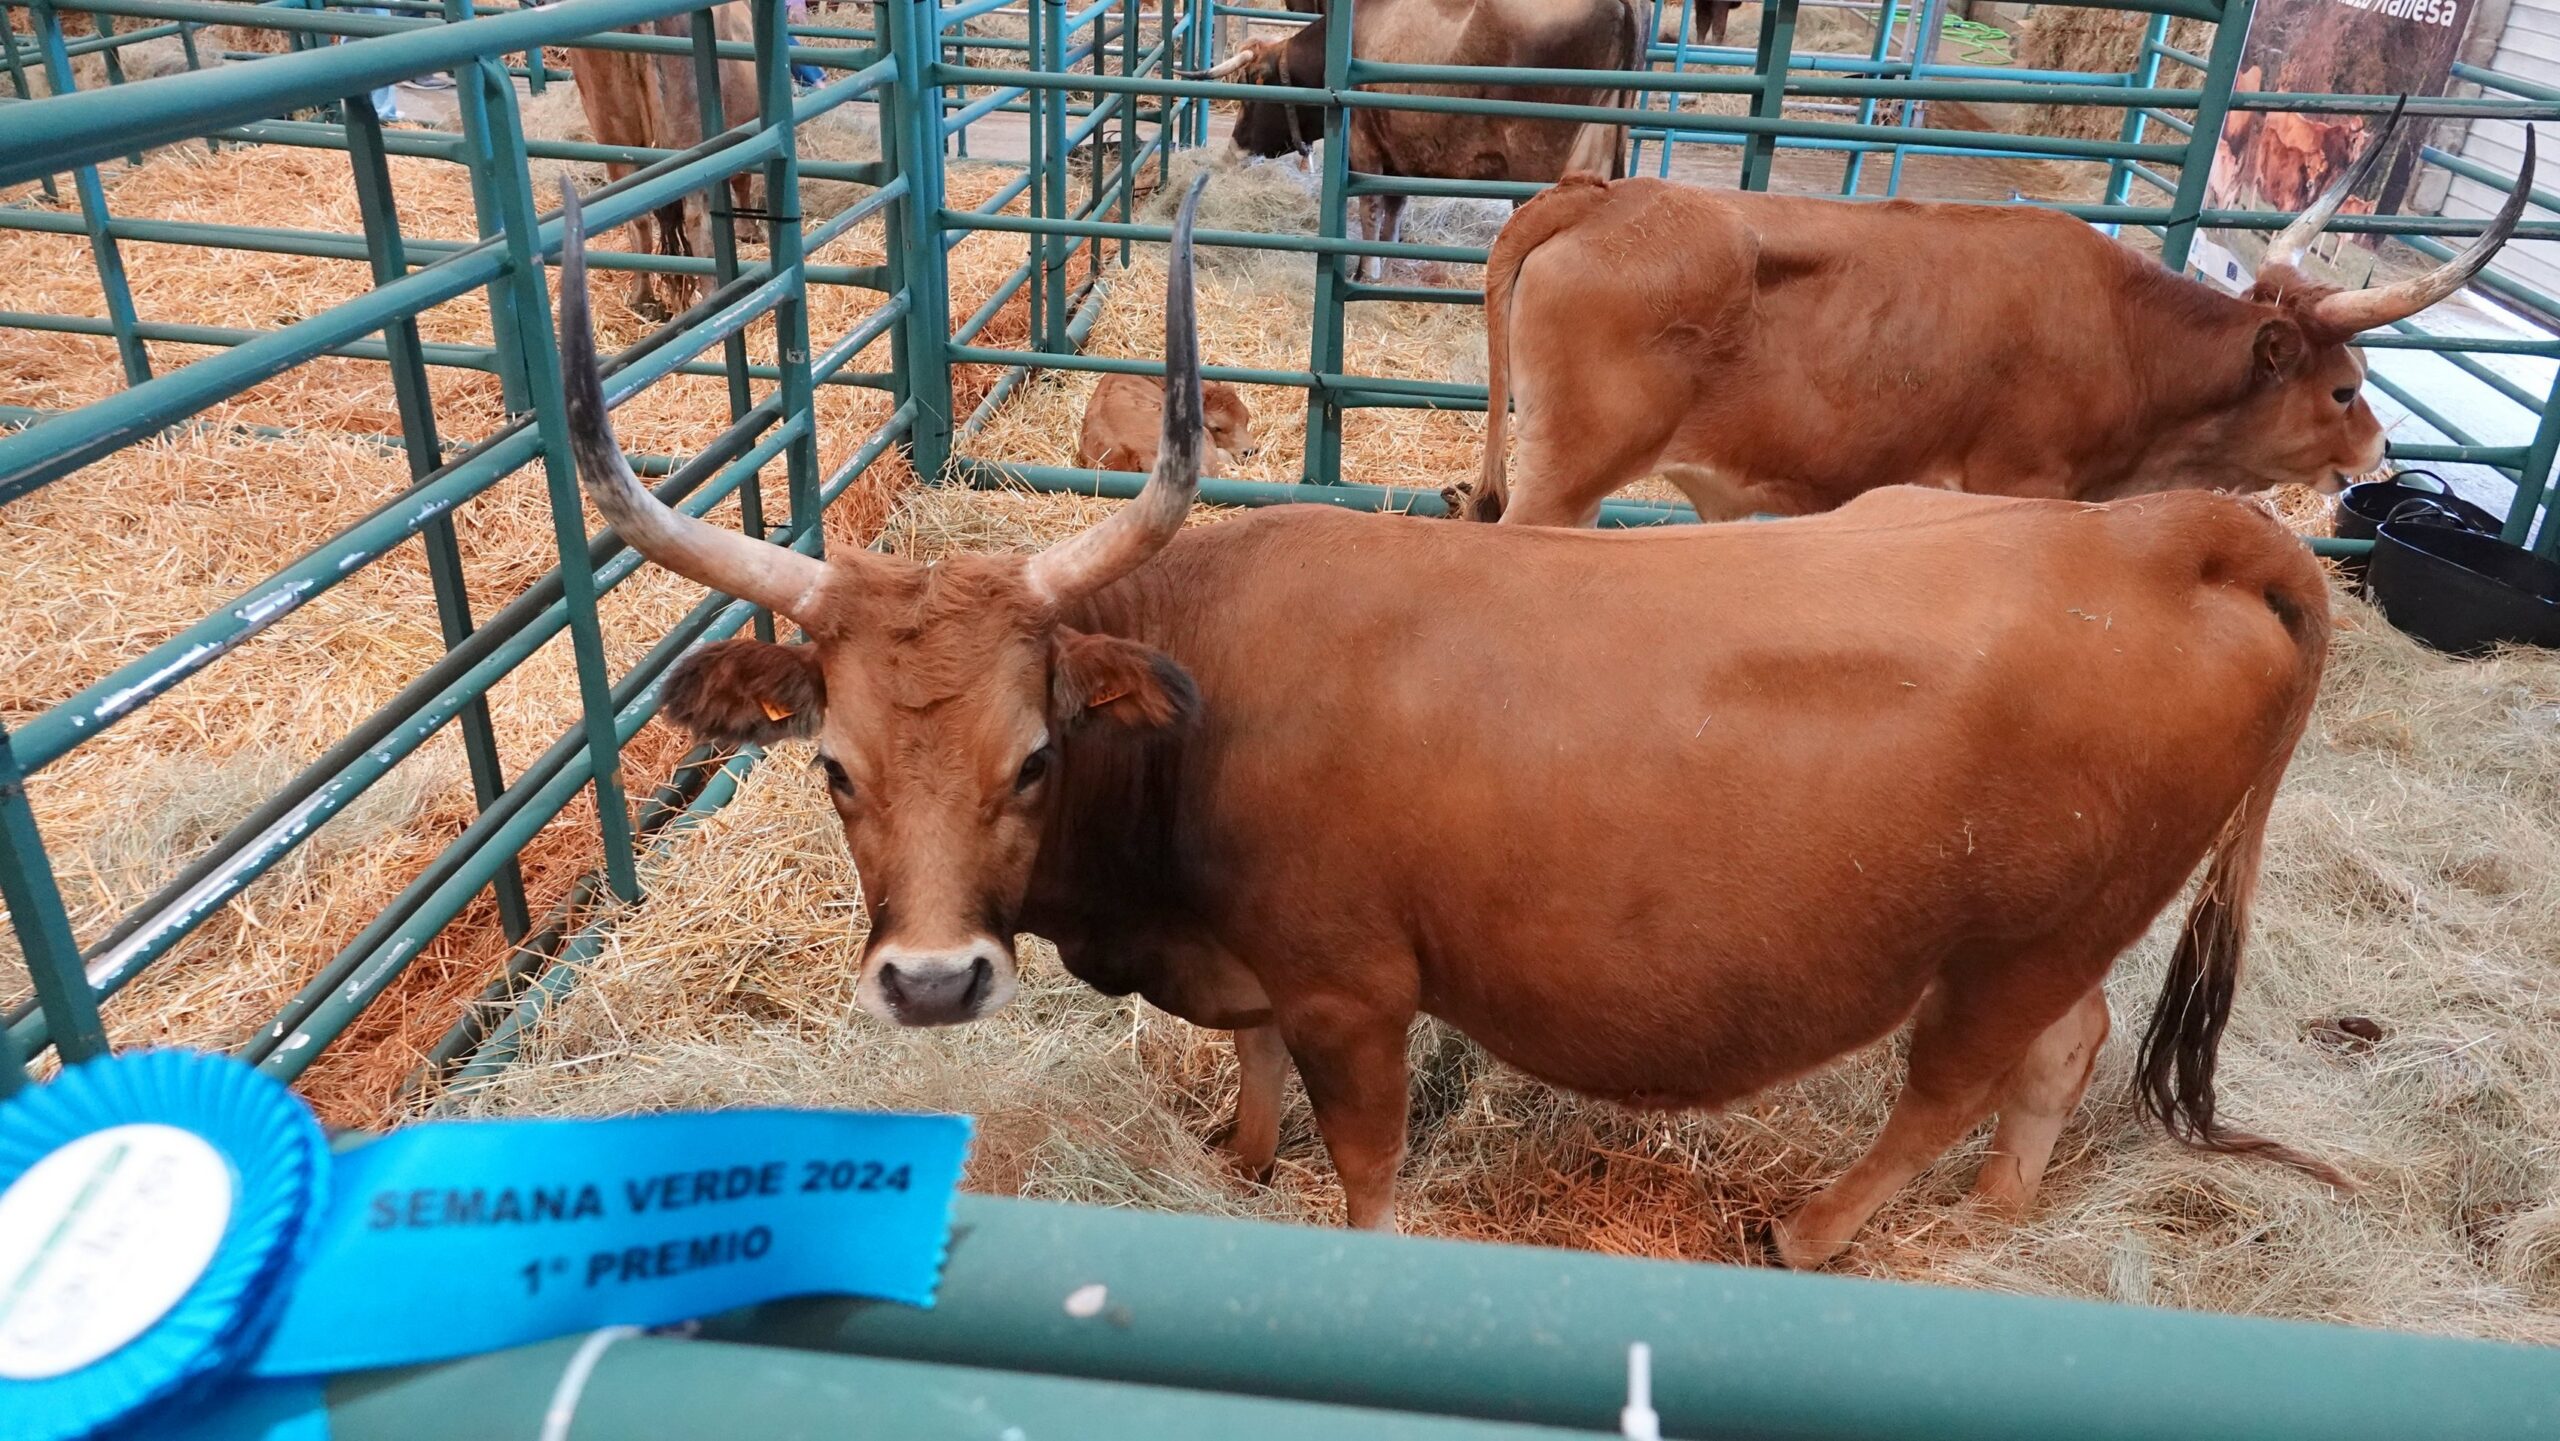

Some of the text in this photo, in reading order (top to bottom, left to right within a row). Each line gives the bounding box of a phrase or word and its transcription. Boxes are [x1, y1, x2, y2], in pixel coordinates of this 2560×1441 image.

[369, 1160, 912, 1231] SEMANA VERDE 2024
[584, 1225, 772, 1290] PREMIO
